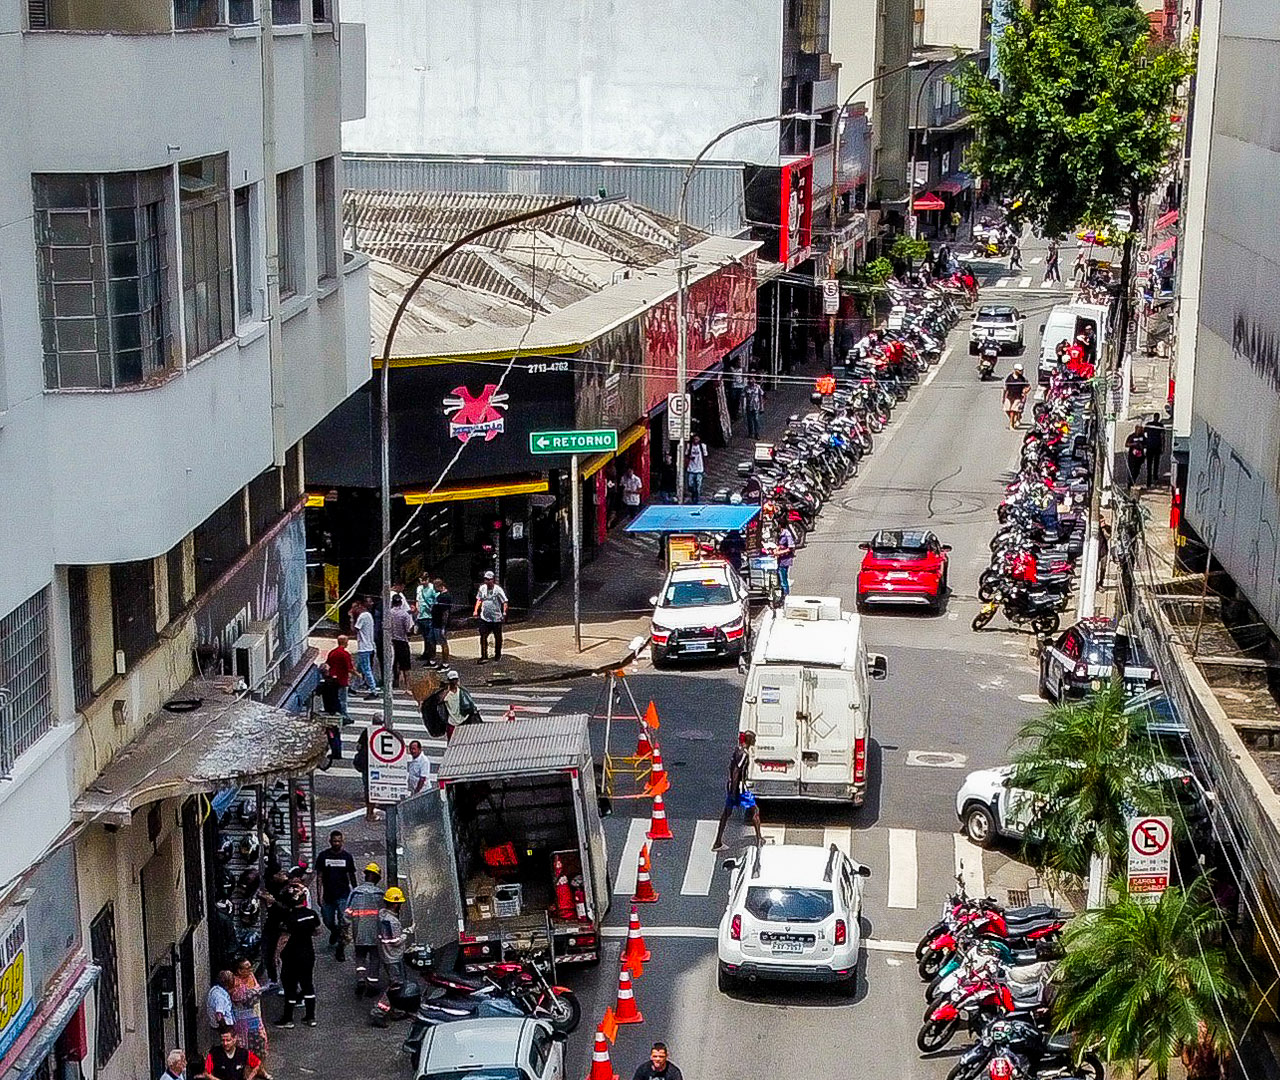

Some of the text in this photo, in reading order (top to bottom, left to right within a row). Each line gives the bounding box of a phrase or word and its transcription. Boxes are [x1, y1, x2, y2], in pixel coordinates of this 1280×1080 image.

[553, 435, 612, 448] RETORNO
[381, 735, 393, 755] E
[1144, 827, 1157, 848] E
